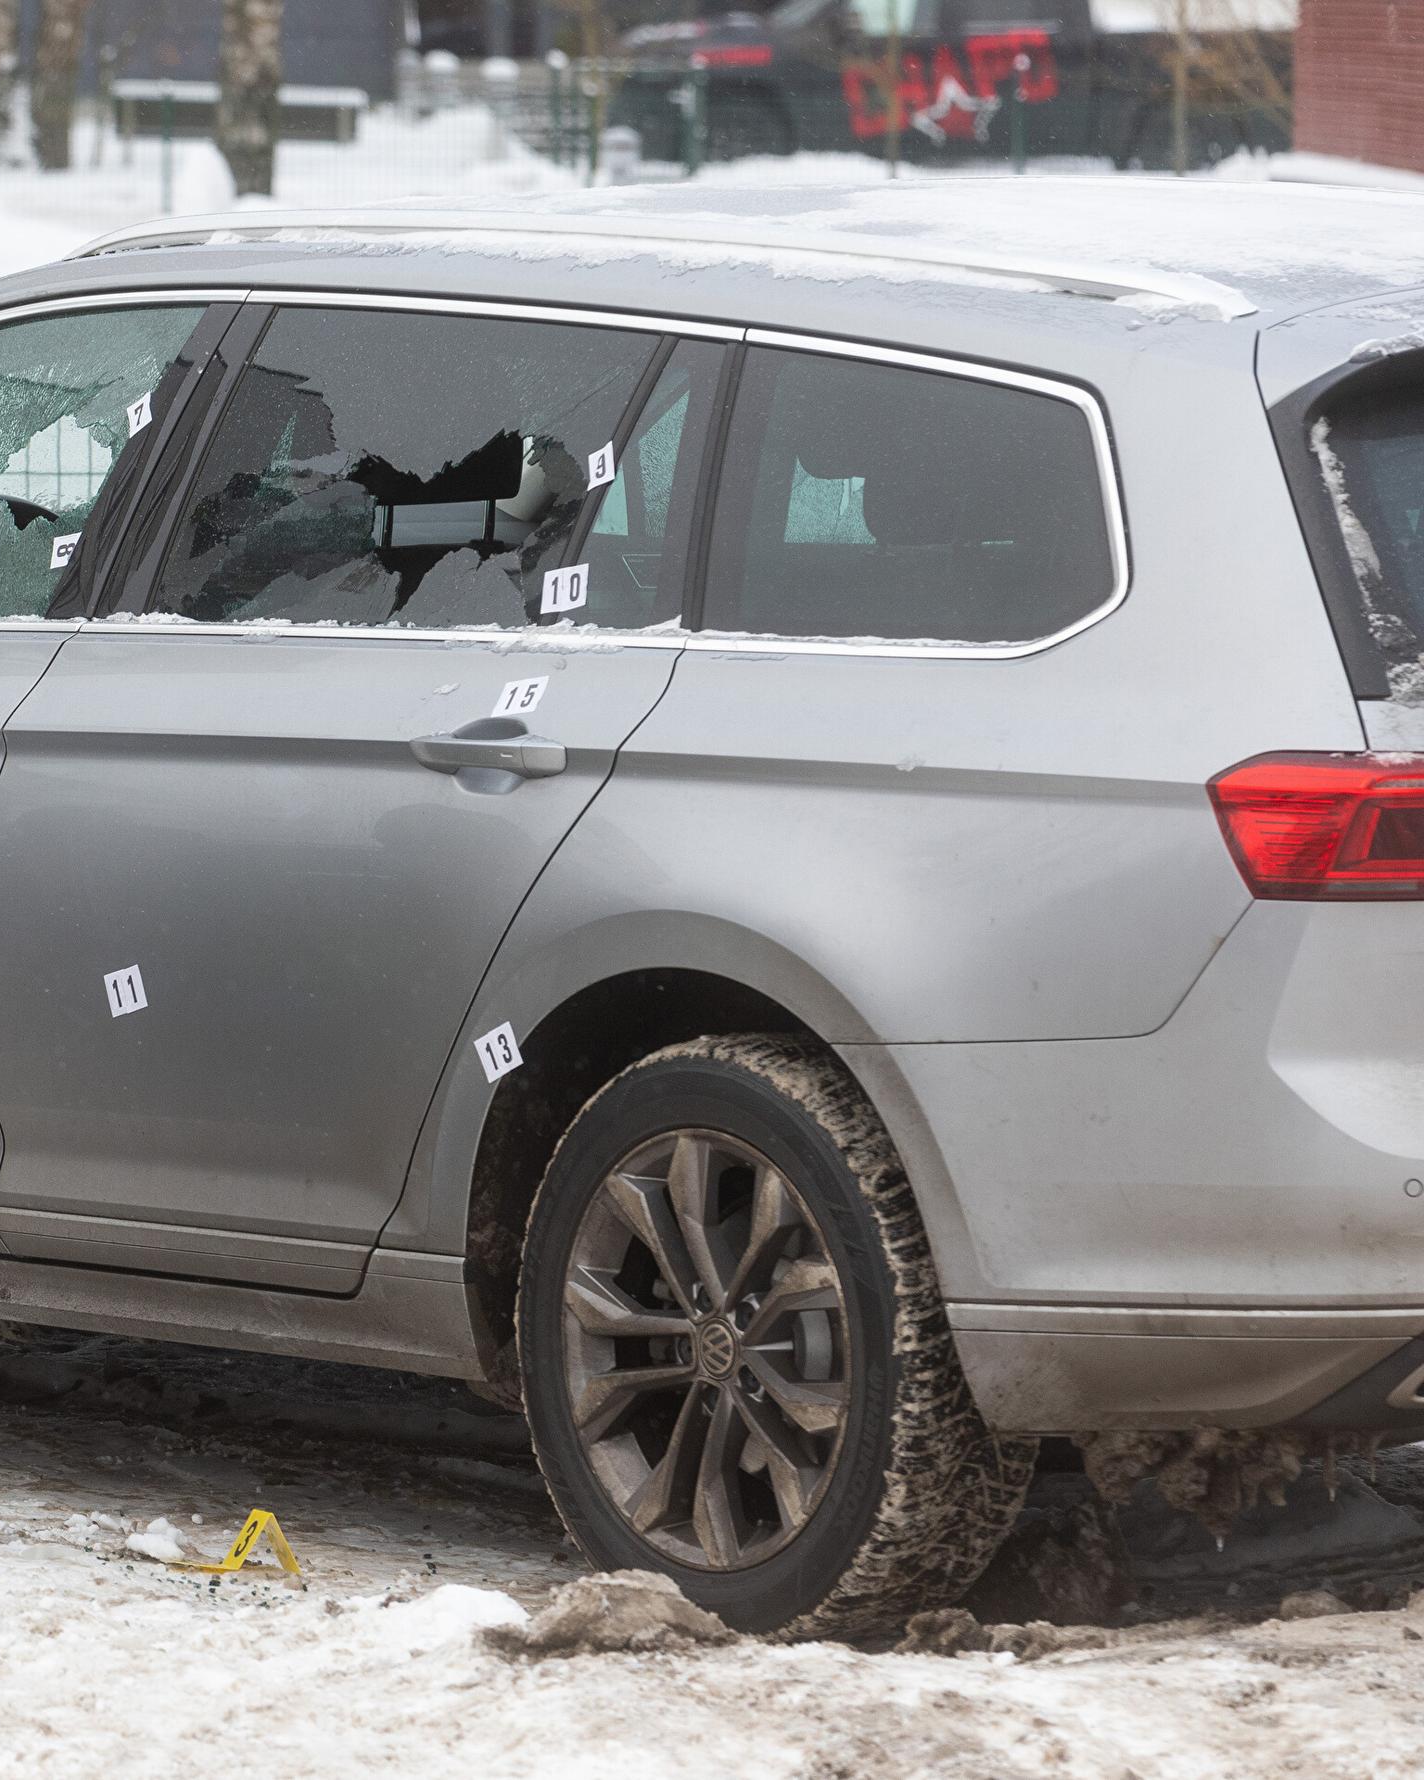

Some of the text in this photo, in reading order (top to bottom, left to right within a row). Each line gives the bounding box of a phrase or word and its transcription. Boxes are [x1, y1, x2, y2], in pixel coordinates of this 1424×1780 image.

[134, 403, 144, 426] 7
[551, 572, 581, 605] 10
[505, 683, 539, 710] 15
[111, 974, 139, 1008] 11
[486, 1032, 514, 1071] 13
